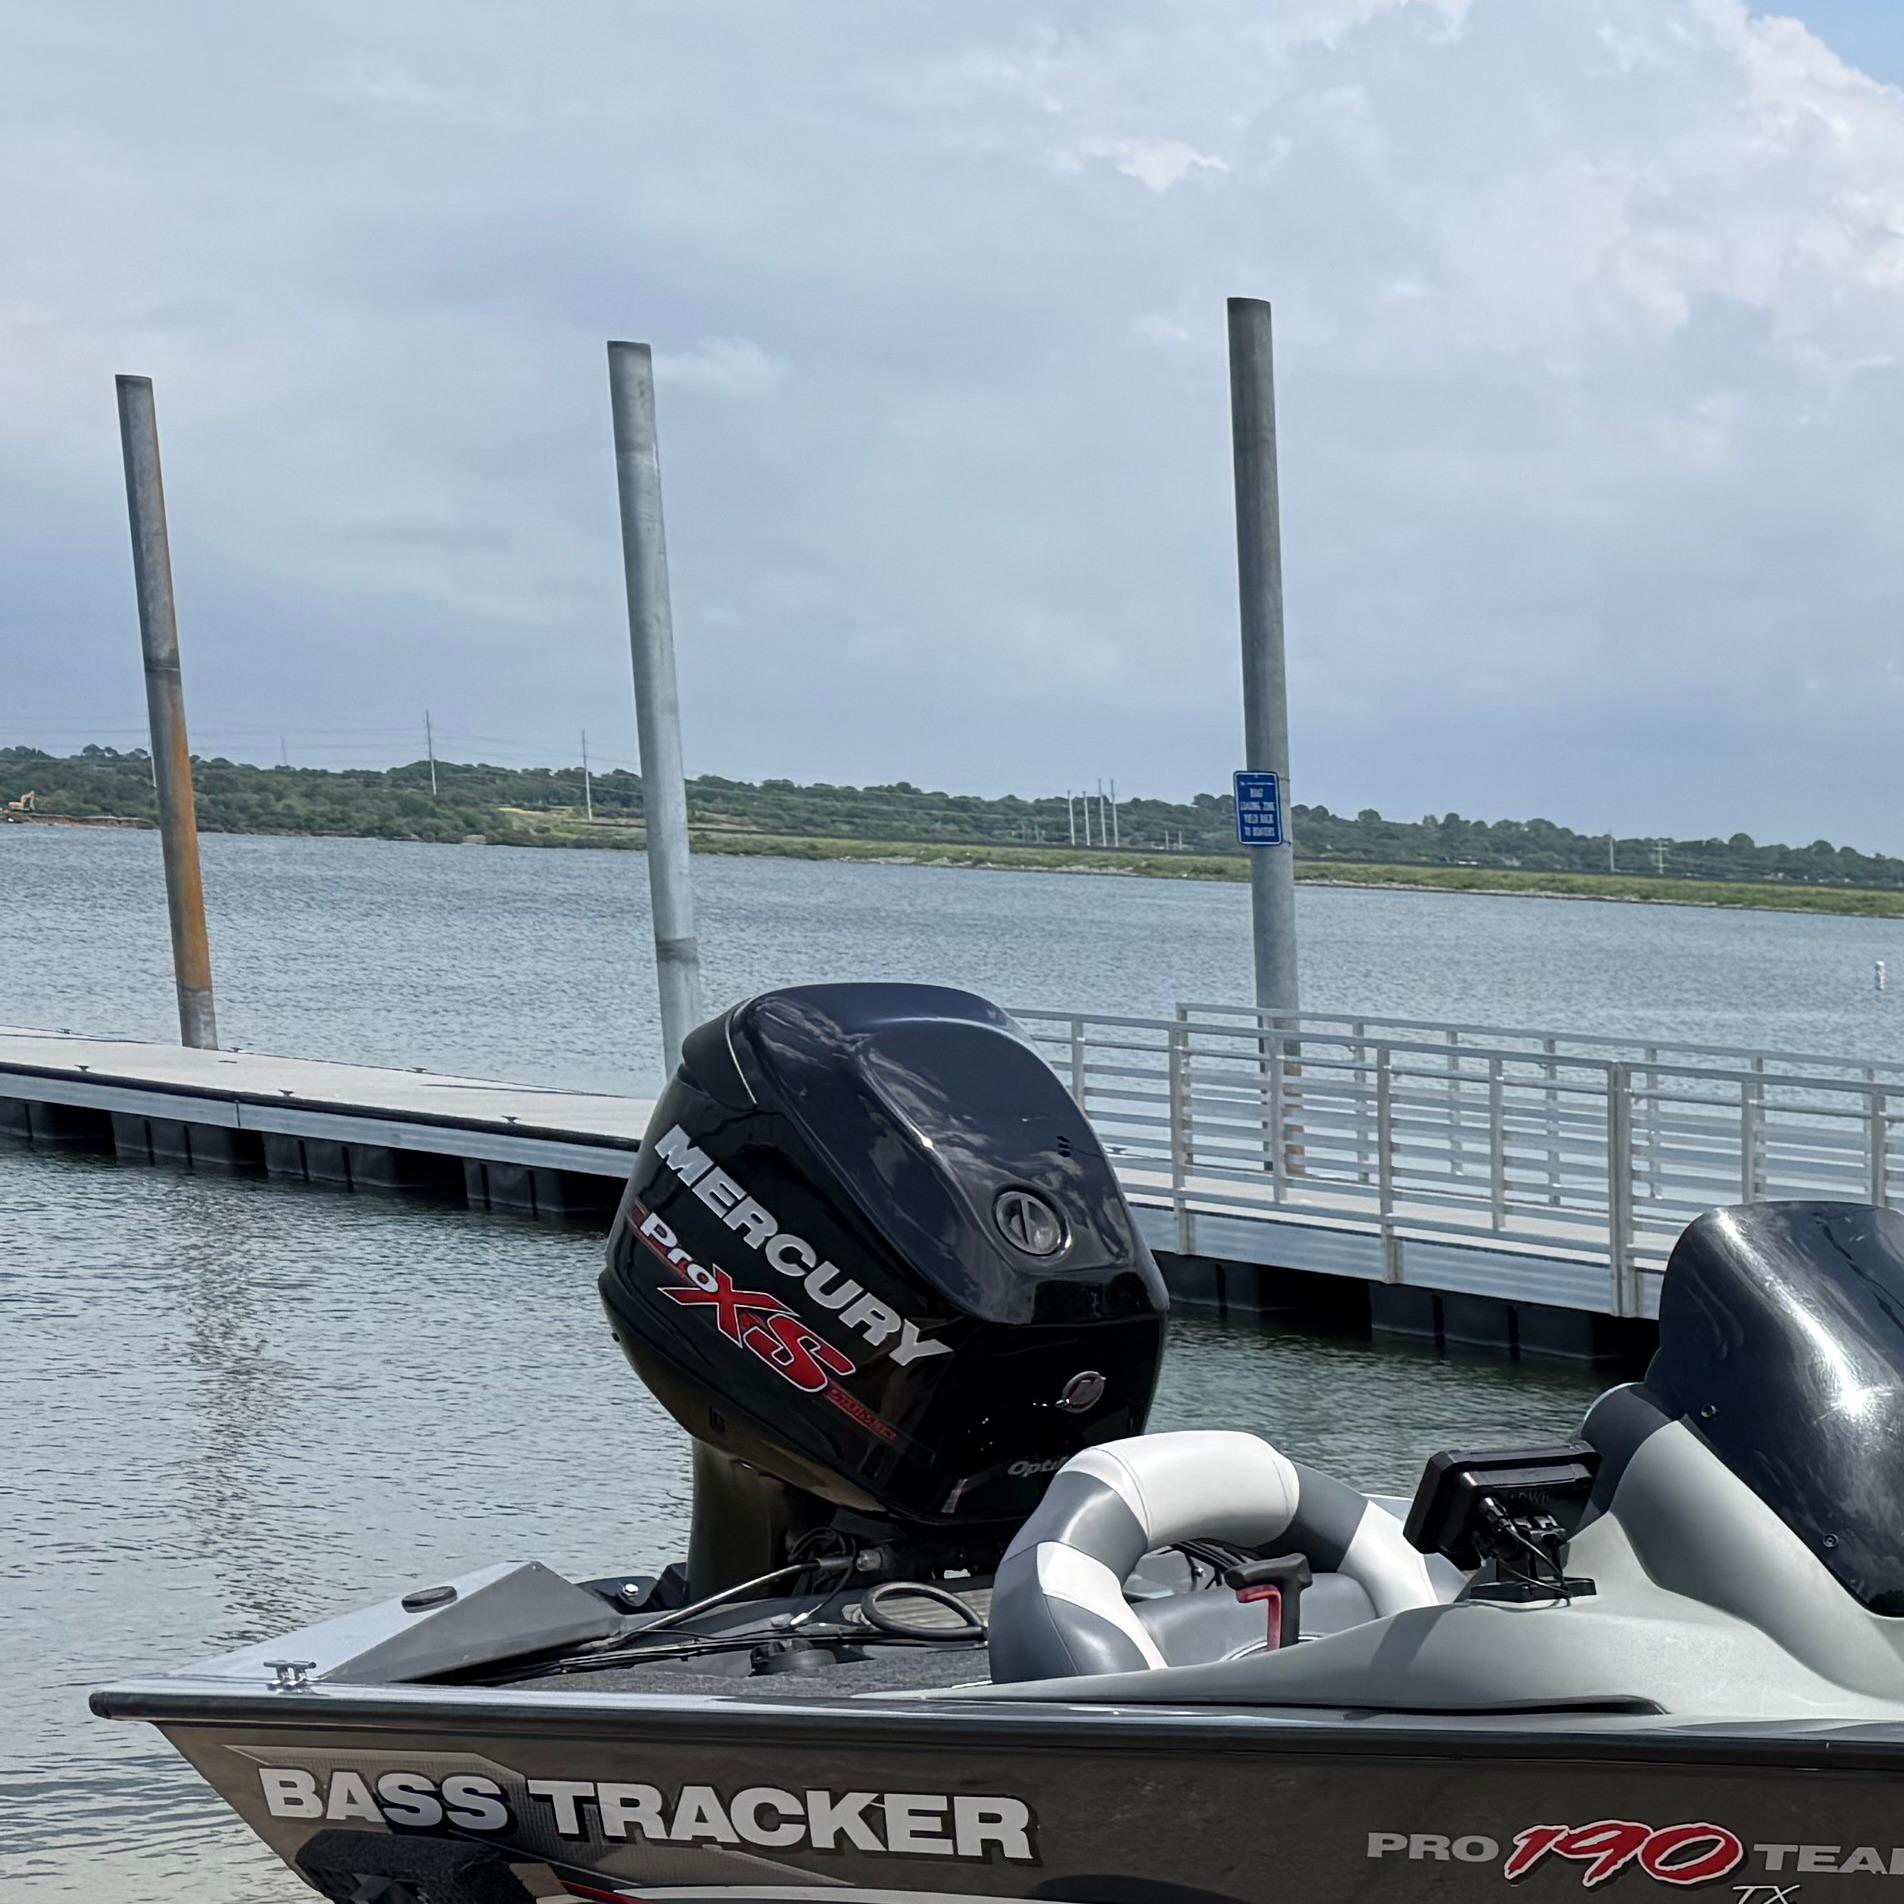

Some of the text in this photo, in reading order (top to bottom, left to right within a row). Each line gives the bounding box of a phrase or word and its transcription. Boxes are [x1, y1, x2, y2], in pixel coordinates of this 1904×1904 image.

[640, 1213, 856, 1392] Pro XS
[655, 1124, 953, 1365] MERCURY
[258, 1767, 1034, 1860] BASS TRACKER
[1367, 1832, 1499, 1862] PRO
[1505, 1820, 1743, 1887] 190
